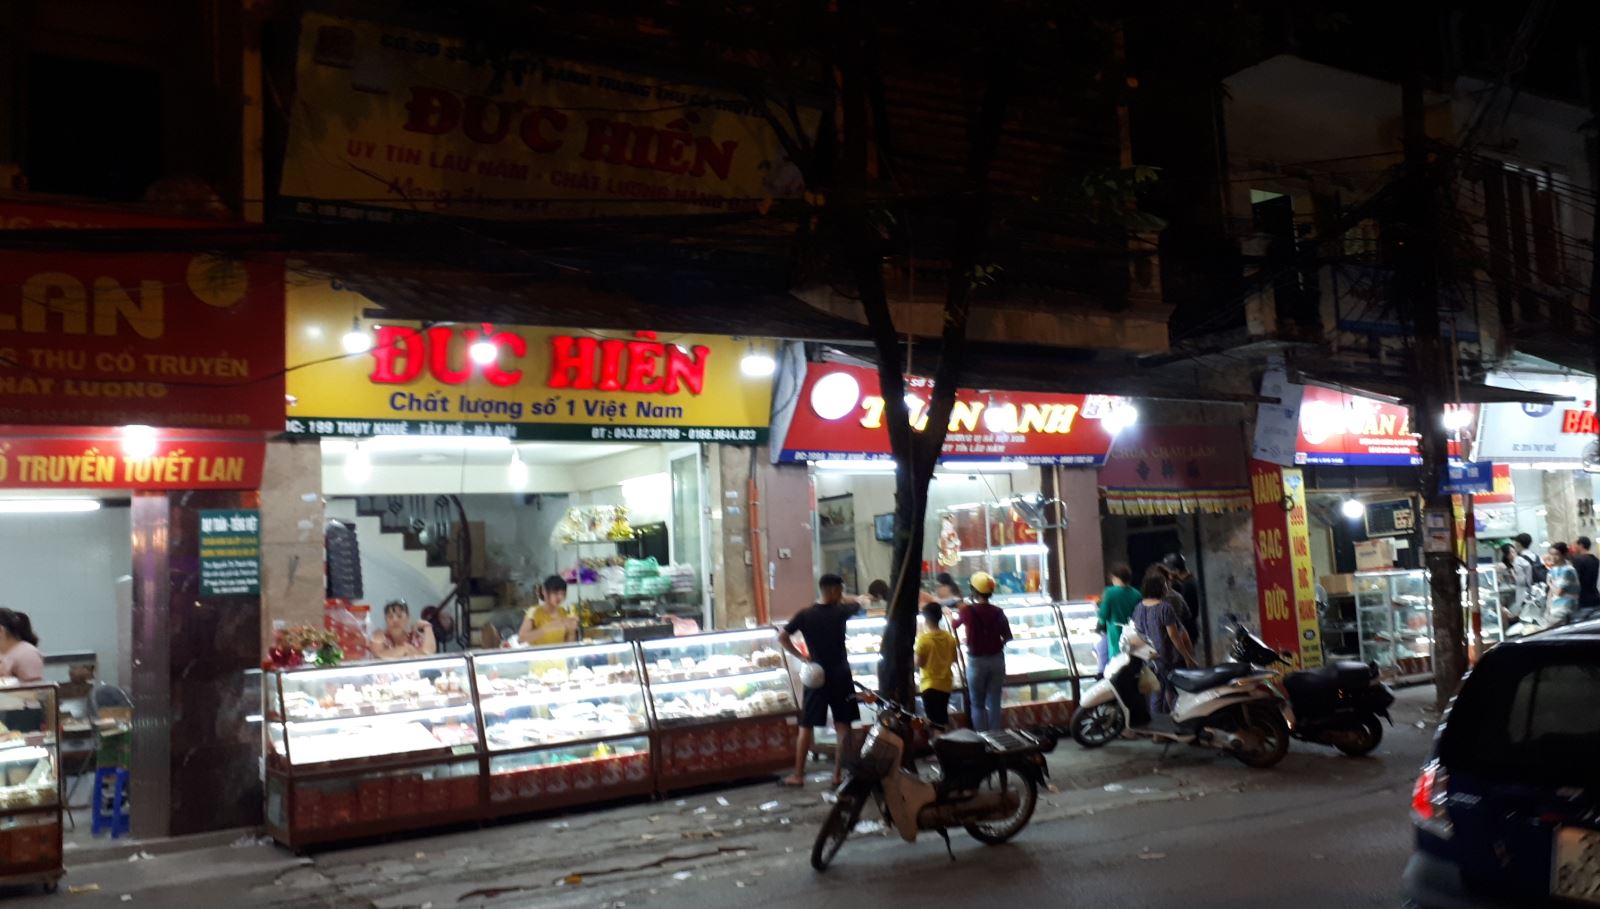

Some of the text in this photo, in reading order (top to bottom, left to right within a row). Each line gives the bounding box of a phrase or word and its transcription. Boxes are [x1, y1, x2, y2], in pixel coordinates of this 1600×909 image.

[29, 347, 86, 371] THU
[389, 389, 684, 422] Chất lượng số 1 Việt Nam
[18, 446, 115, 482] TRUYỀN
[123, 448, 194, 482] TUYẾT
[198, 456, 245, 482] LAN
[1252, 467, 1281, 505] VÀNG
[1258, 528, 1284, 567] BẠC
[1264, 582, 1290, 621] ĐỨC
